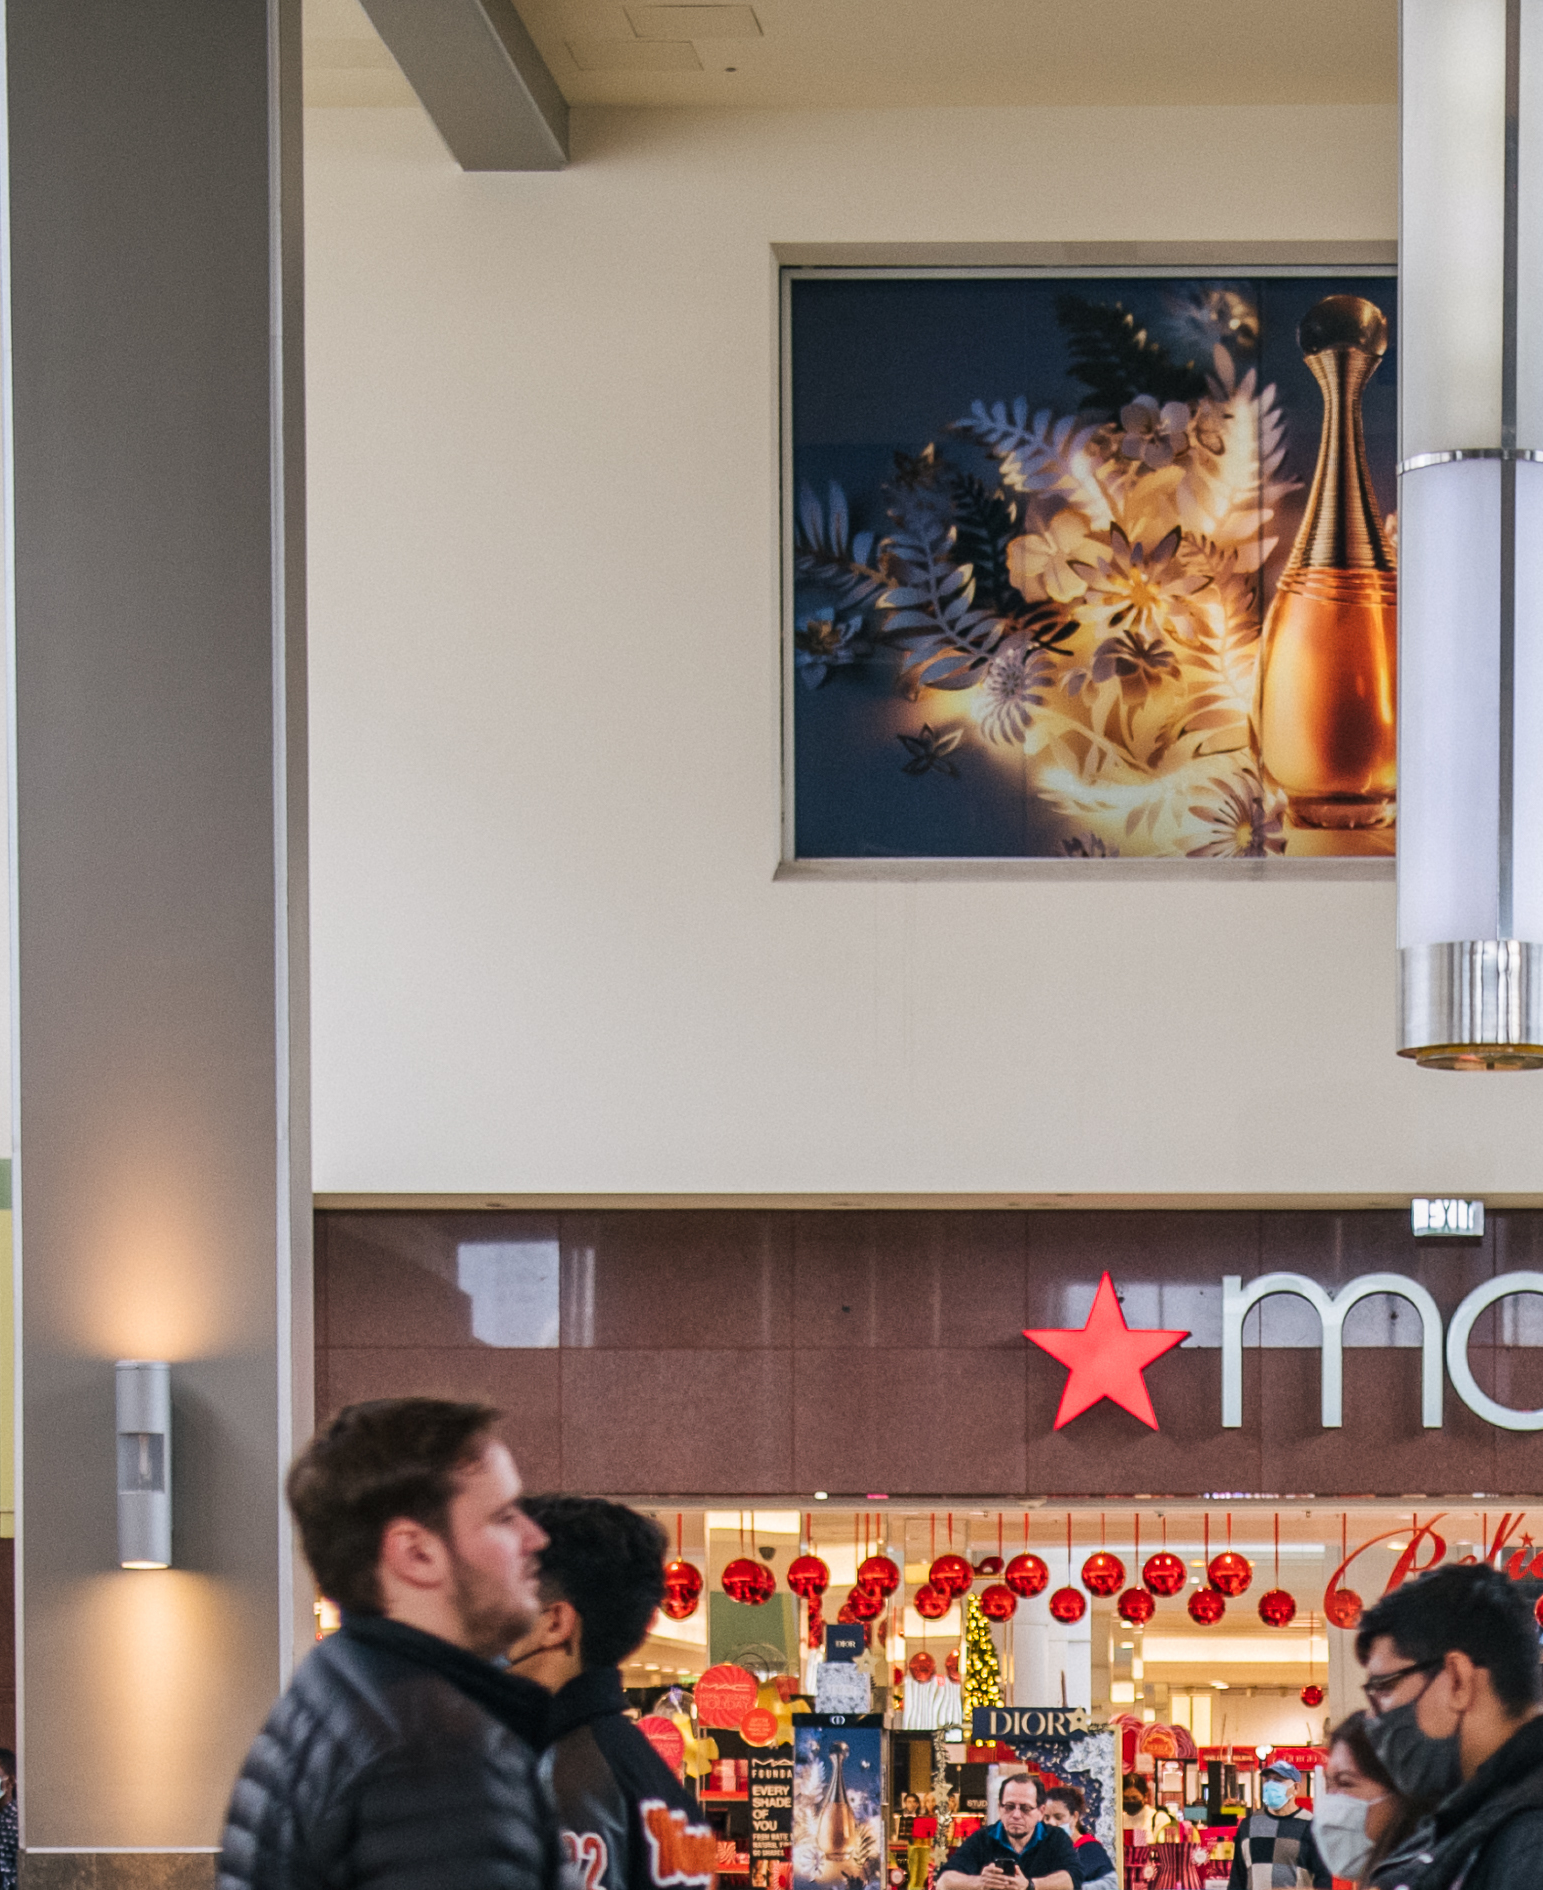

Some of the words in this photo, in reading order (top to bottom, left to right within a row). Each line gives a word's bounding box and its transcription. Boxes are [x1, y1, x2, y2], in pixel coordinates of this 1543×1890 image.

[989, 1711, 1068, 1736] DIOR
[751, 1785, 790, 1796] EVERY
[752, 1797, 792, 1808] SHADE
[752, 1809, 769, 1820] OF
[752, 1820, 777, 1831] YOU
